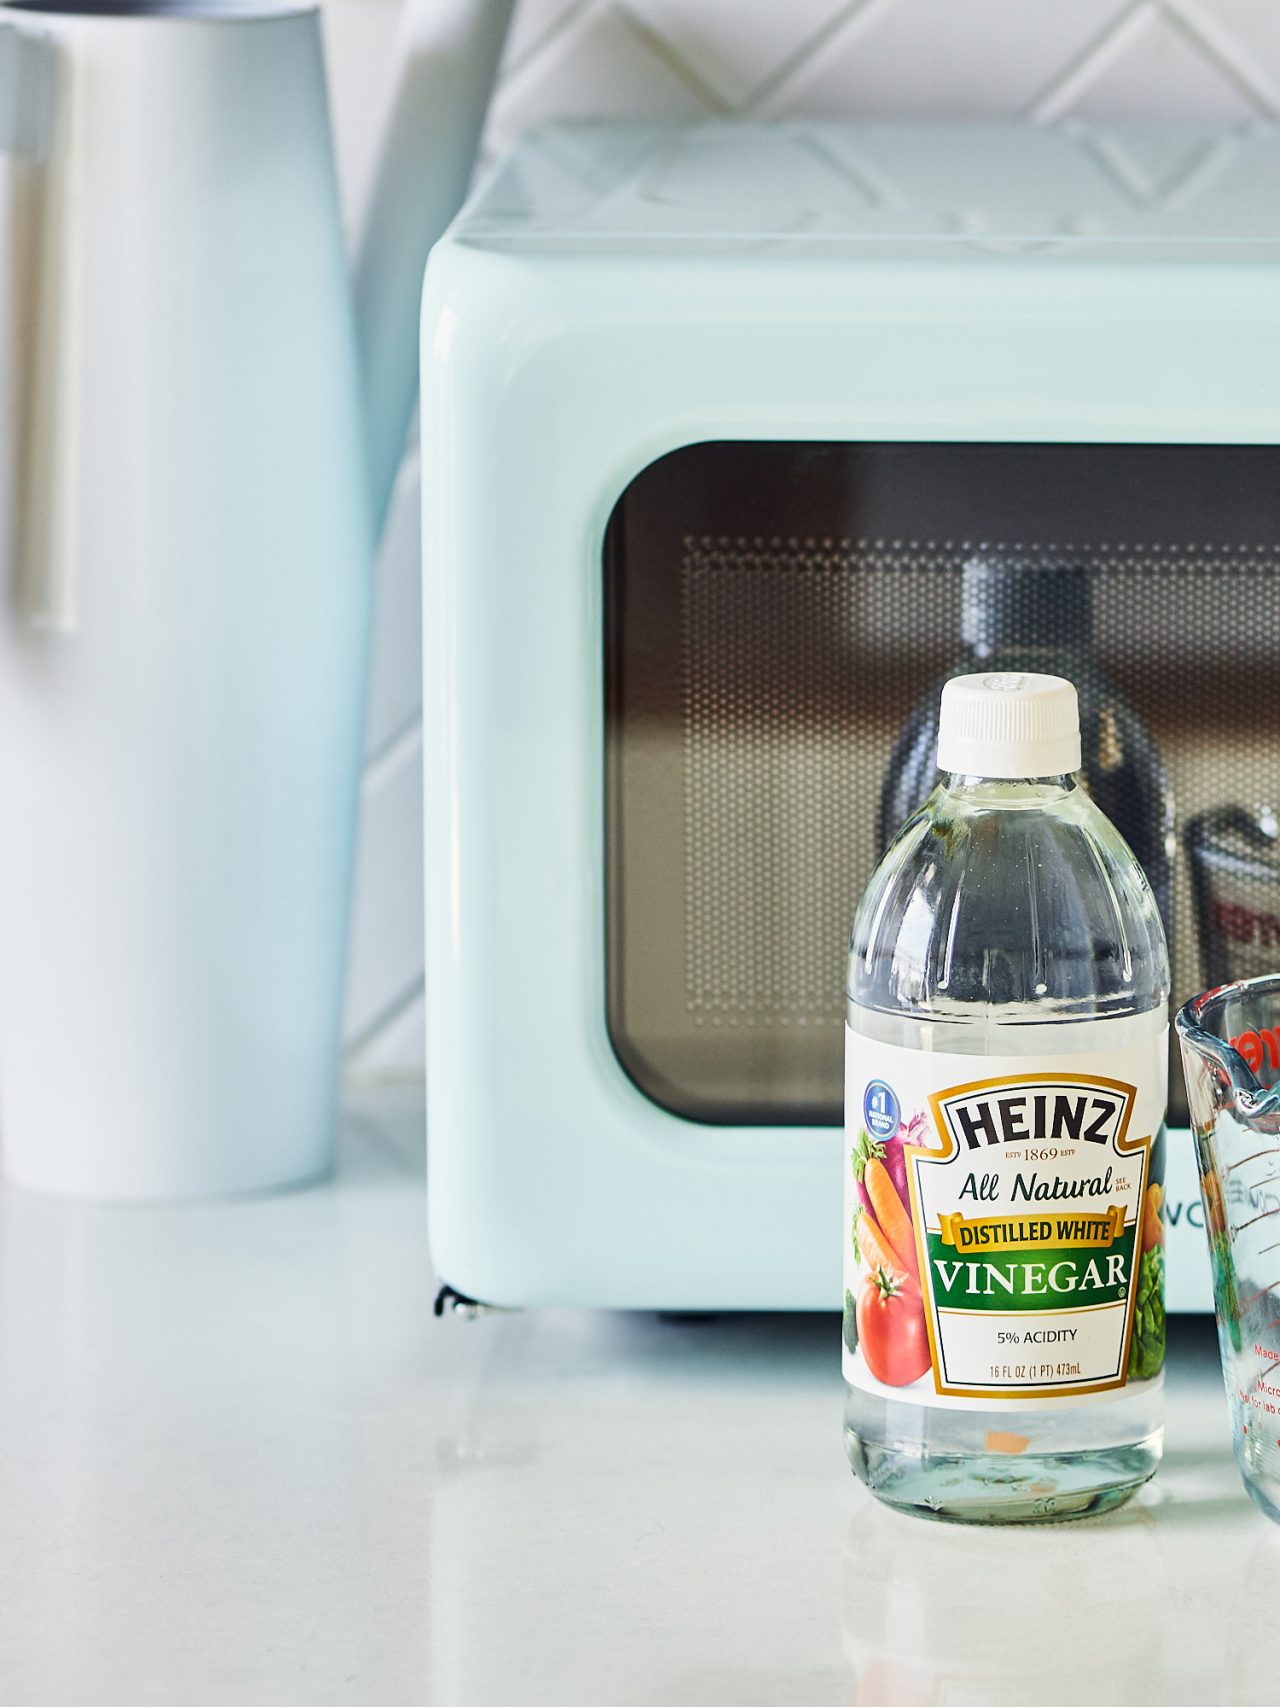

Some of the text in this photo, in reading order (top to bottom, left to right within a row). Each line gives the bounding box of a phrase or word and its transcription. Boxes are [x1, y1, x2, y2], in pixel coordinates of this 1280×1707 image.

[871, 1091, 886, 1114] #1
[868, 1110, 894, 1124] NATIONAL
[956, 1094, 1117, 1150] HEINZ
[1024, 1147, 1058, 1161] 1869
[958, 1165, 1113, 1202] All Natural
[1115, 1176, 1127, 1185] SEE
[1115, 1183, 1131, 1192] BACK
[959, 1220, 1111, 1247] DISTILLED WHITE
[933, 1254, 1128, 1296] VINEGAR
[997, 1328, 1078, 1344] 5% ACIDITY
[1254, 1344, 1279, 1361] Made
[990, 1361, 1081, 1380] 16 FL OZ (1 PT) 473mL
[1263, 1400, 1276, 1414] lab
